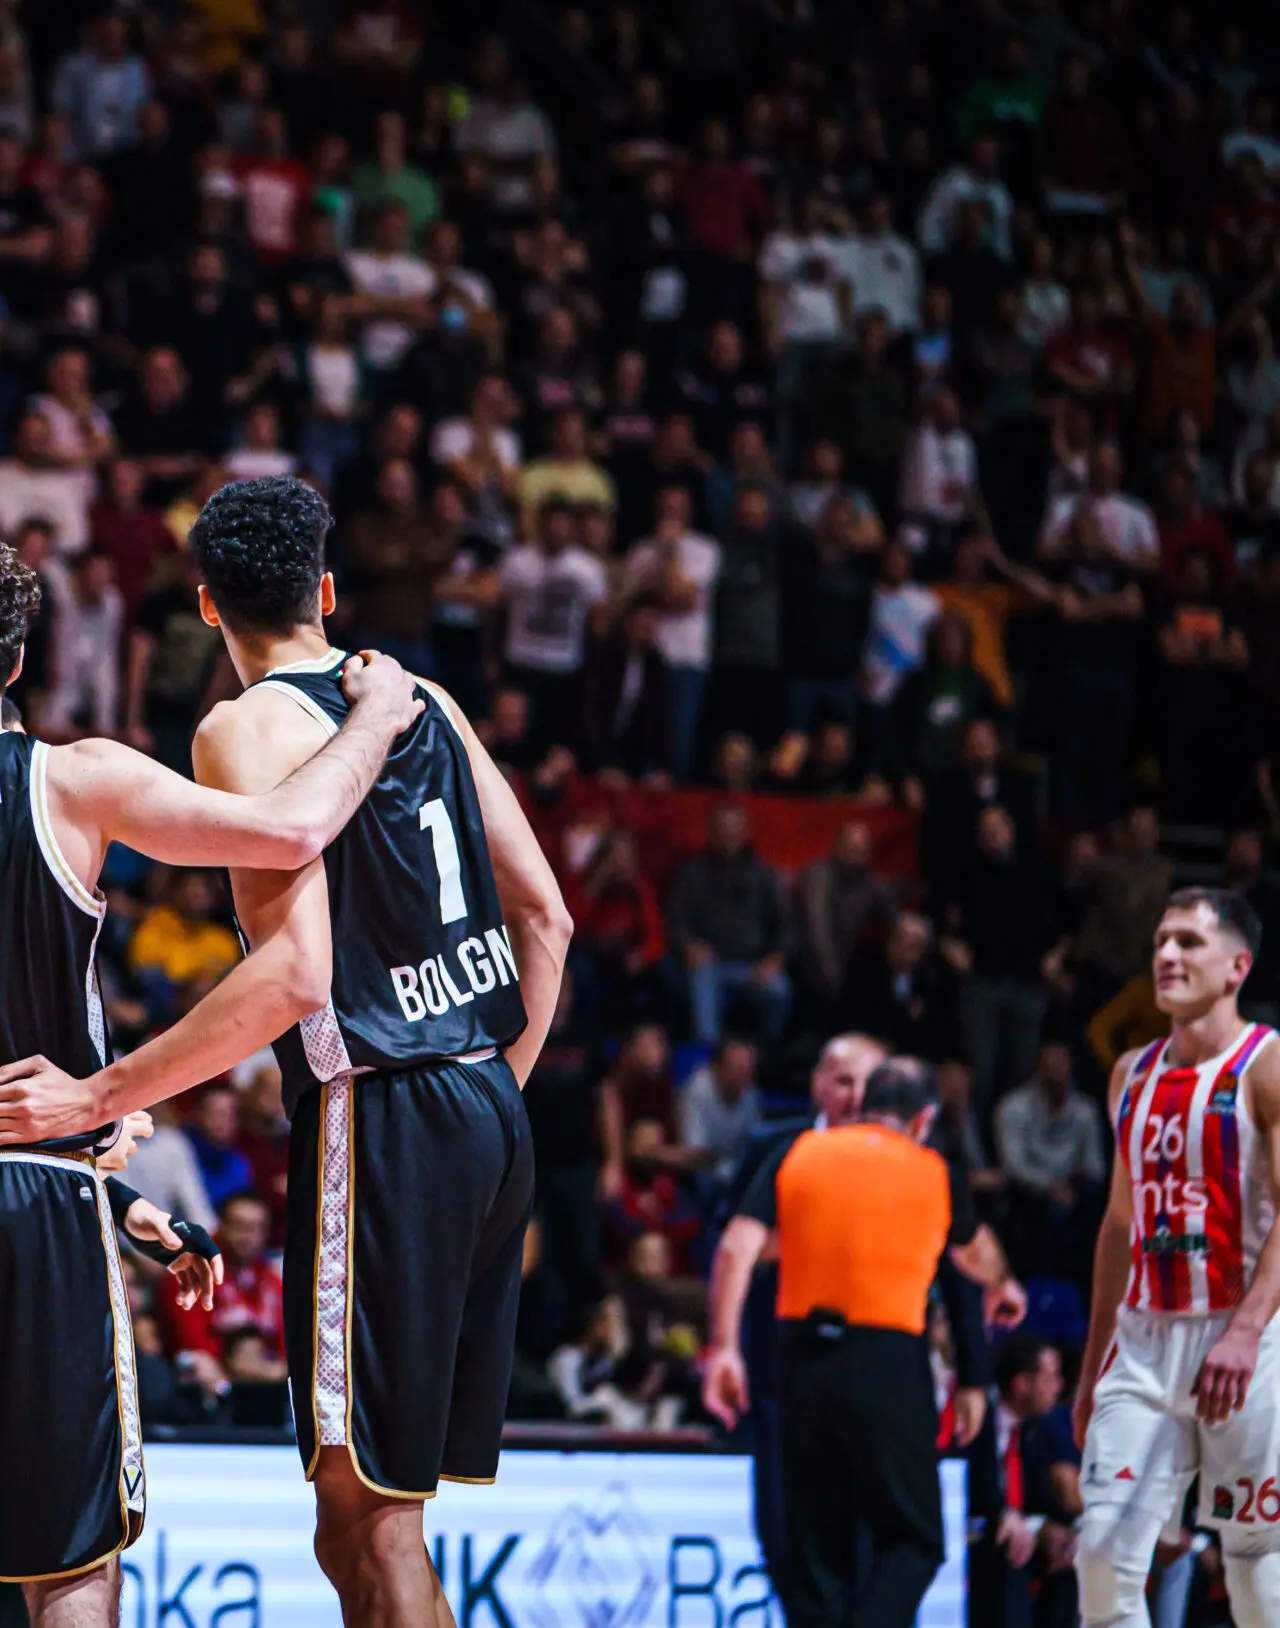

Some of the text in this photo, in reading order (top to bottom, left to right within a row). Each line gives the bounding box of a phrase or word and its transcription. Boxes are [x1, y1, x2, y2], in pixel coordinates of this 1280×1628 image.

[419, 798, 468, 925] 1
[1143, 1113, 1184, 1163] 26
[1235, 1476, 1280, 1524] 26
